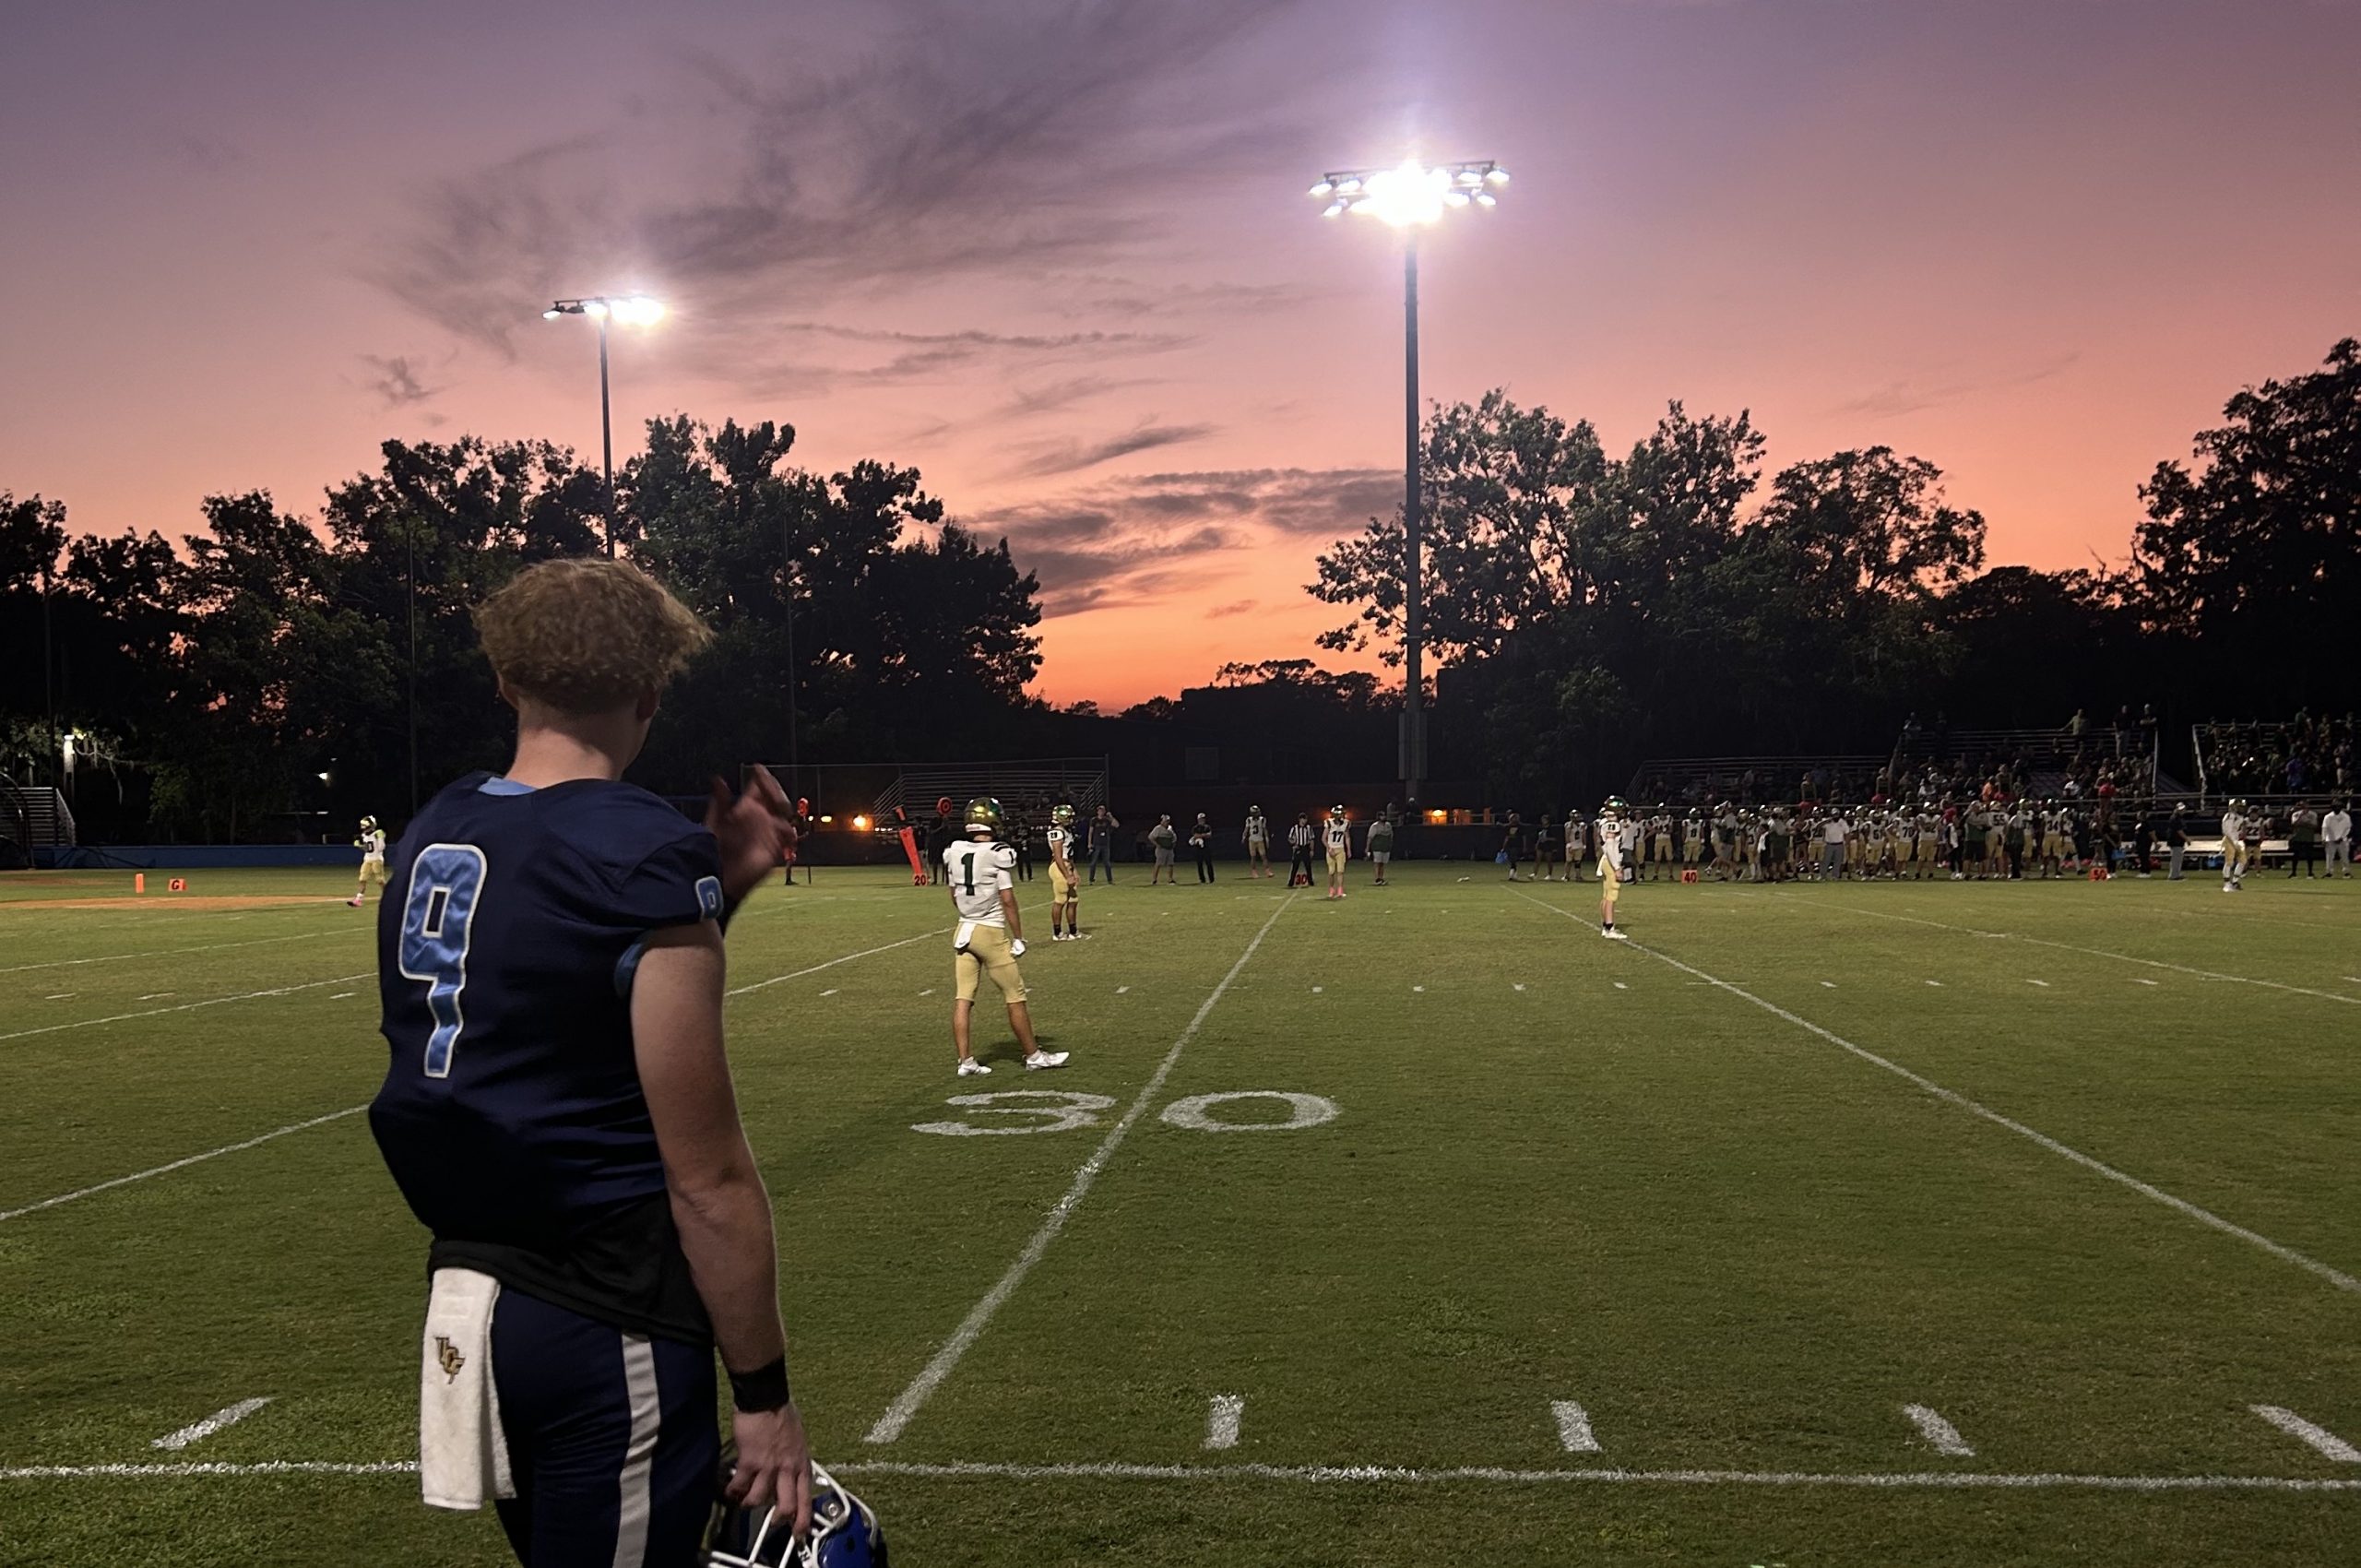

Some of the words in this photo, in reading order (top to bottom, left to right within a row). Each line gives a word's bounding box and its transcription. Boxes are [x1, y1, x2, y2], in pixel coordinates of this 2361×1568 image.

[1332, 830, 1344, 843] 17
[1008, 850, 1014, 864] 1
[914, 874, 927, 886] 20
[960, 852, 976, 896] 1
[1295, 873, 1308, 885] 30
[1684, 872, 1697, 883] 40
[172, 879, 180, 890] G
[397, 843, 488, 1079] 9
[908, 1089, 1340, 1136] 30
